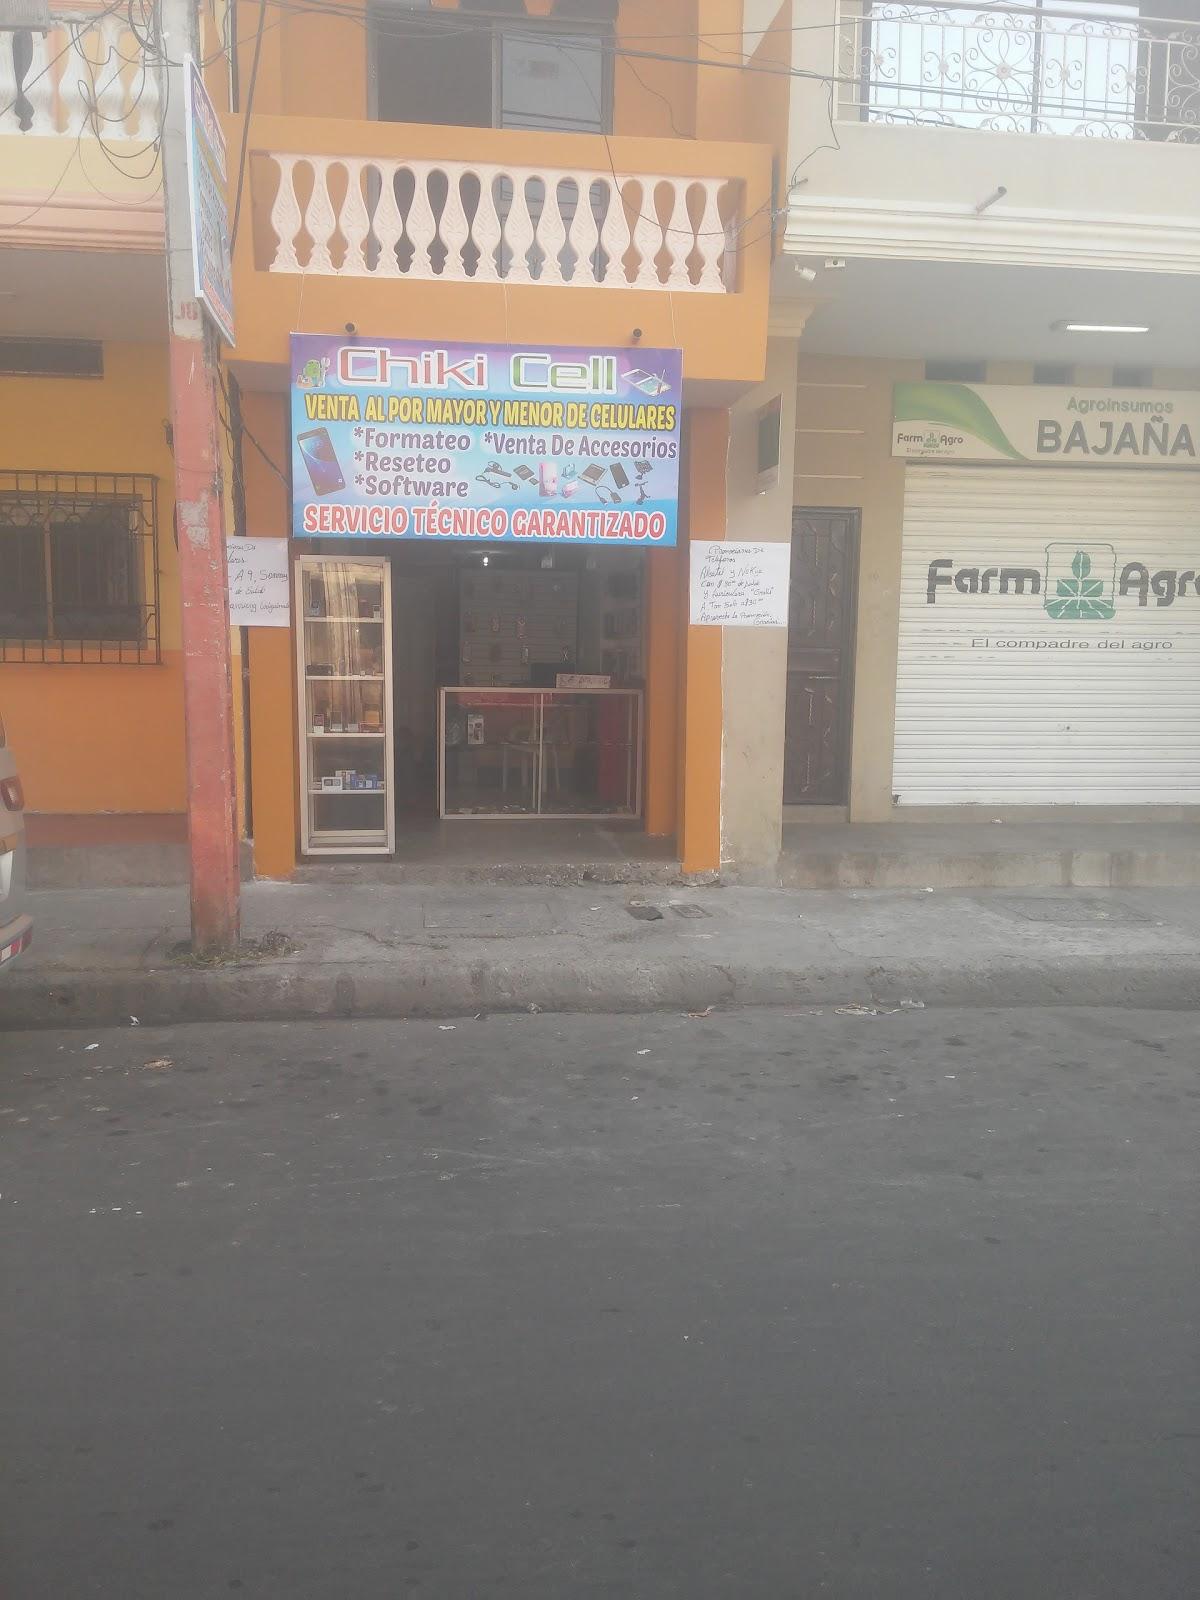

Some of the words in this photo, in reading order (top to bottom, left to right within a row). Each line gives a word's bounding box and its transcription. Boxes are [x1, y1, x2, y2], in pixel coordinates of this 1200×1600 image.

[339, 347, 486, 388] Chiki
[511, 354, 615, 392] Cell
[304, 394, 360, 421] VENTA
[366, 395, 386, 422] AL
[388, 396, 423, 424] POR
[427, 397, 487, 425] MAYOR
[490, 400, 501, 425] Y
[504, 400, 563, 427] MENOR
[566, 402, 588, 428] DE
[590, 403, 676, 430] CELULARES
[1067, 396, 1173, 414] Agroinsumos
[552, 435, 575, 455] De
[578, 435, 677, 458] Accesorios
[897, 433, 923, 444] Farm
[941, 435, 964, 446] Agro
[1036, 417, 1196, 456] BAJAÑA
[304, 505, 408, 534] SERVICIO
[412, 500, 506, 536] TÉCNICO
[512, 510, 666, 538] GARANTIZADO
[926, 559, 1041, 604] Farm
[972, 639, 989, 648] El
[995, 638, 1089, 649] compadre
[1098, 638, 1124, 648] del
[1131, 640, 1172, 649] agro
